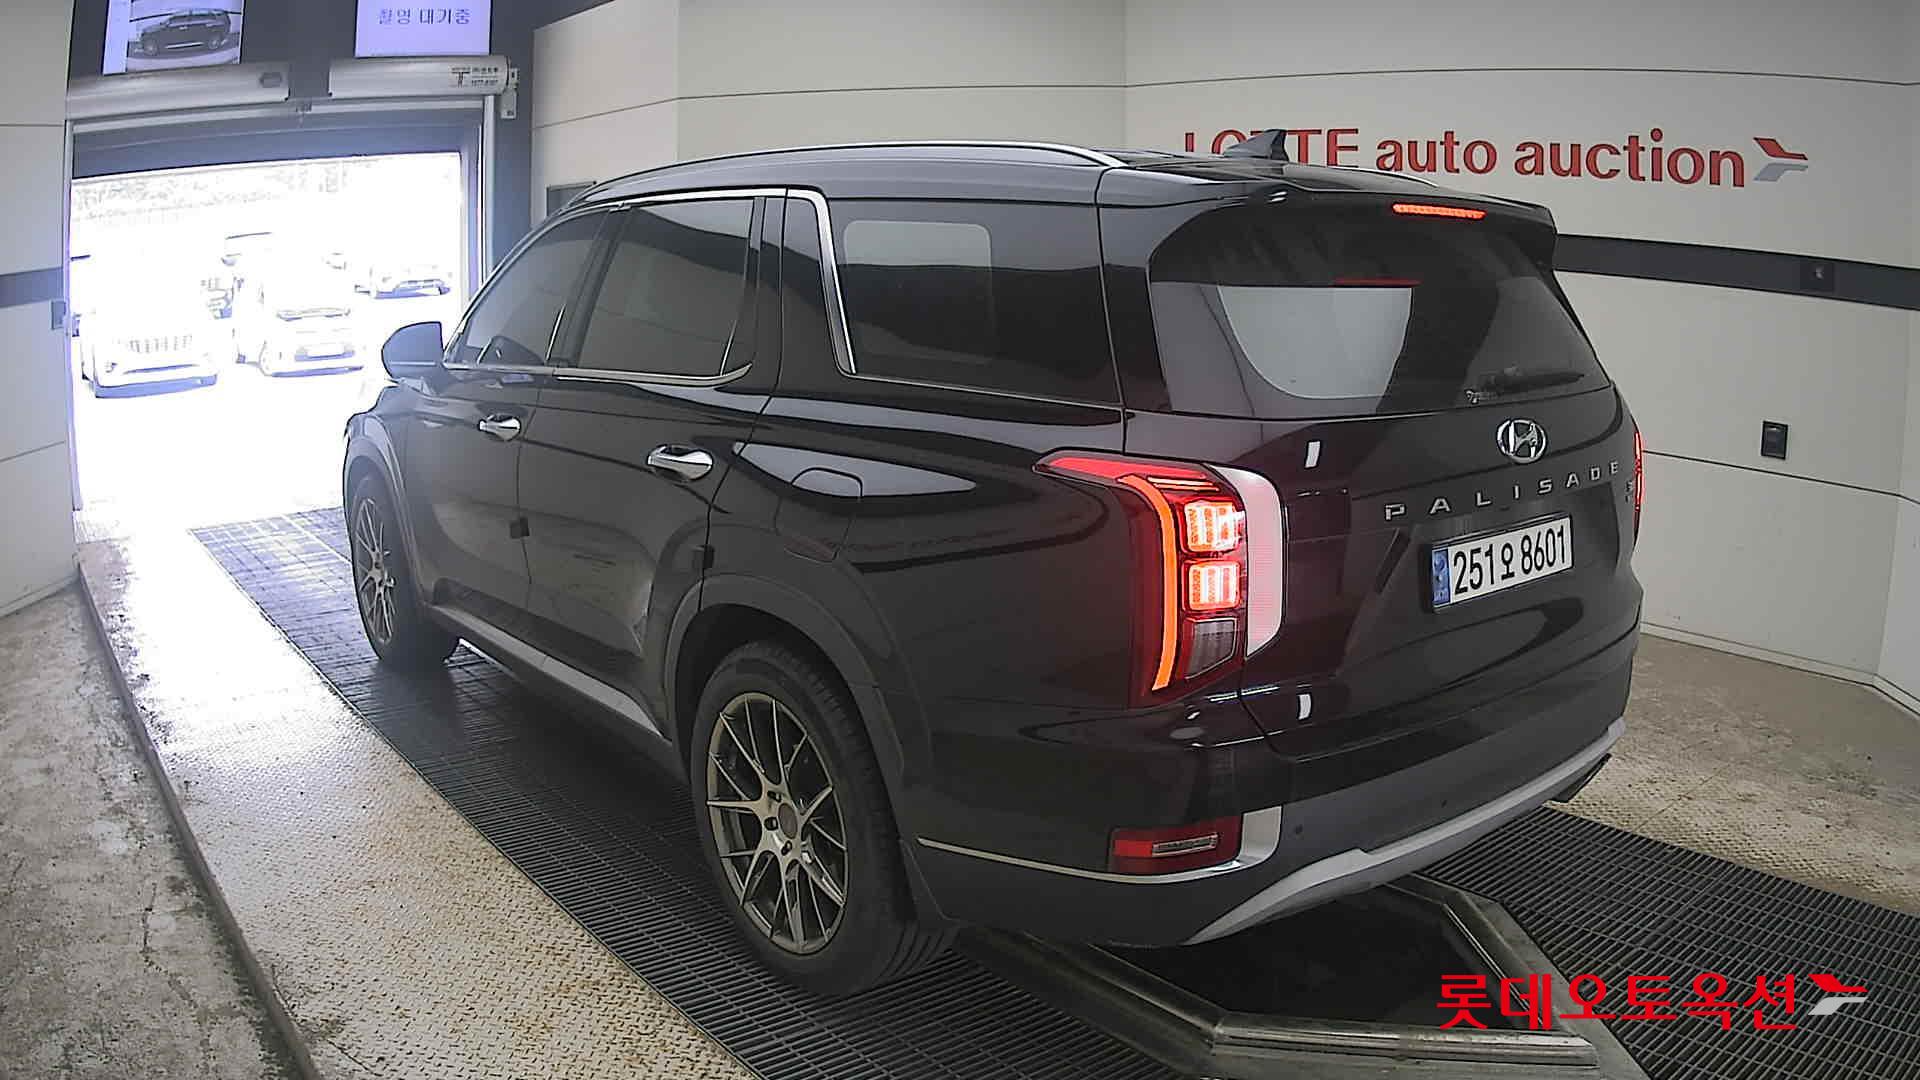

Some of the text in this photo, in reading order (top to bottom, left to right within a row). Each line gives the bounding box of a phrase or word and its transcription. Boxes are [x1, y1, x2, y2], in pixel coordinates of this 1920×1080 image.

[419, 8, 472, 25] 대기중
[1376, 130, 1498, 175] auto
[1514, 128, 1746, 188] auction
[1384, 460, 1619, 521] PALISADE
[1453, 524, 1568, 596] 251오 8601
